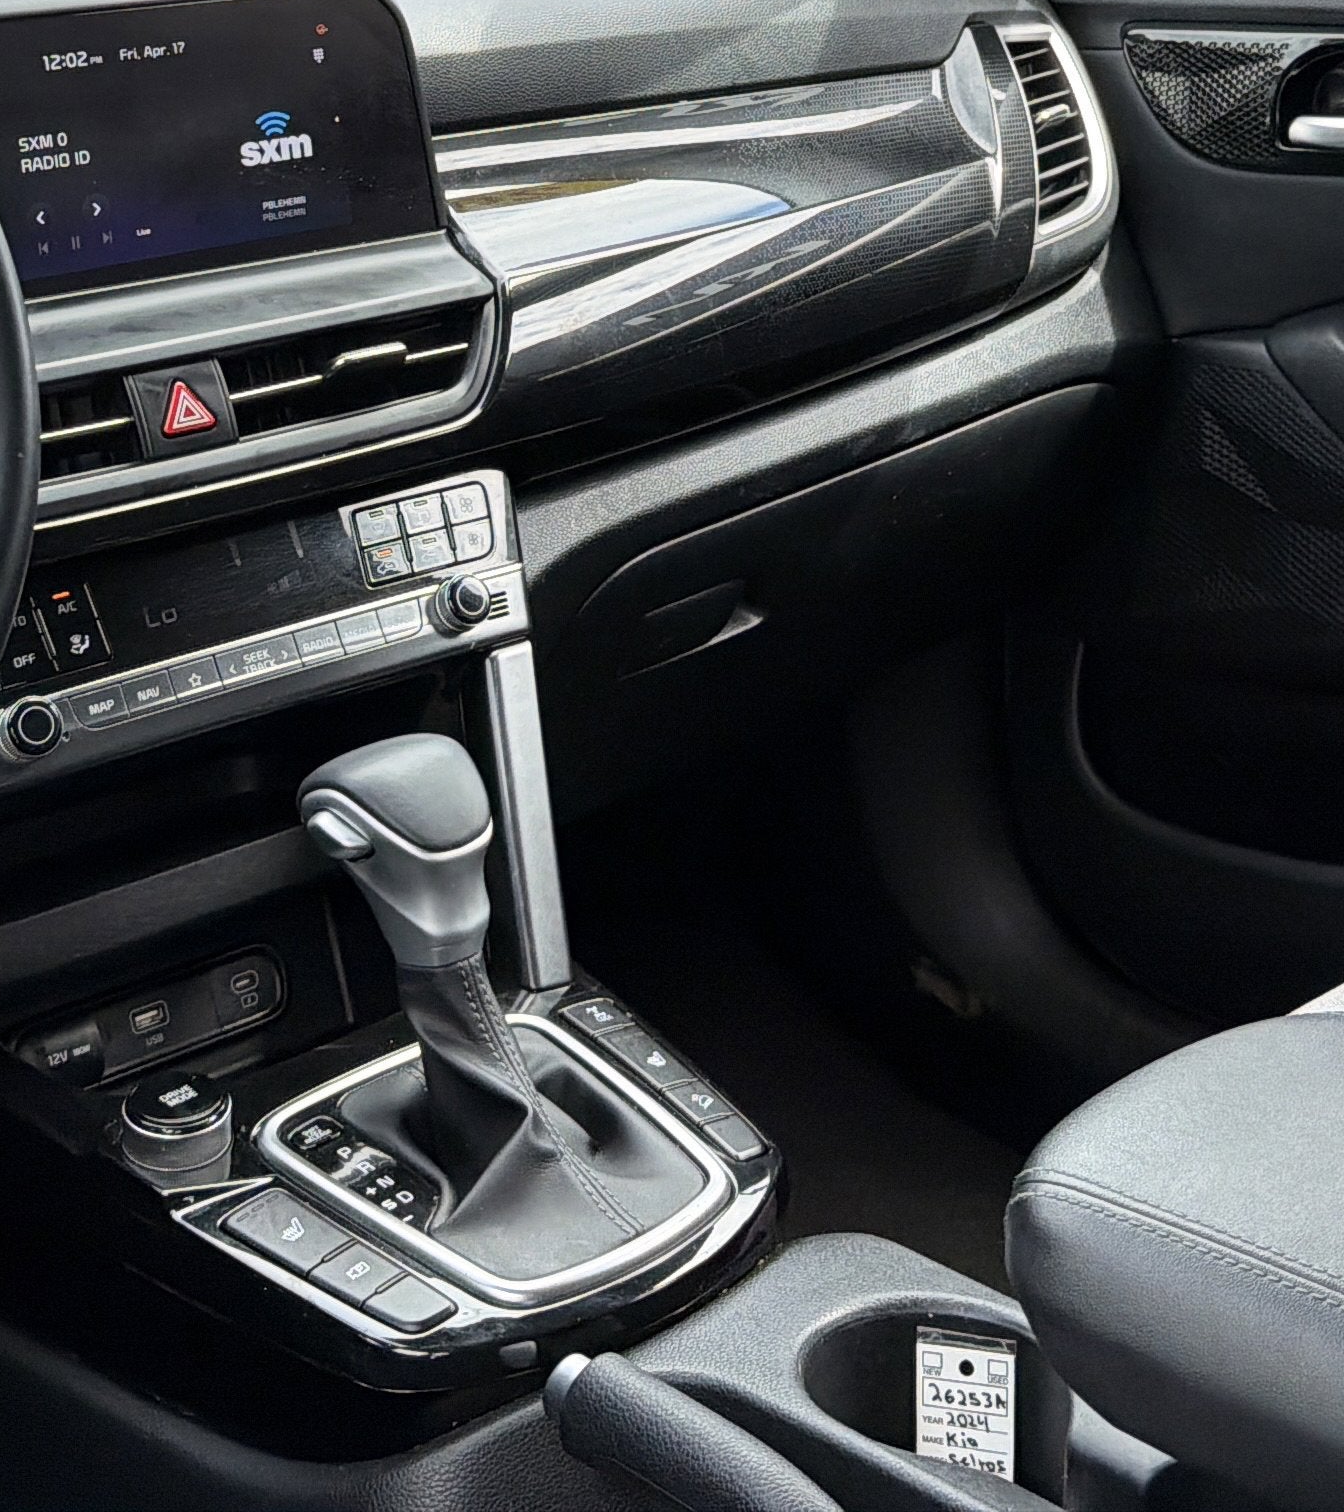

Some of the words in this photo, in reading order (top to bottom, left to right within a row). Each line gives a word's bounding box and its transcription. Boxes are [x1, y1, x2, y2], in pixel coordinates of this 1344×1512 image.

[42, 51, 89, 72] 12:02
[89, 54, 104, 65] PM
[143, 45, 171, 59] Apr.
[172, 41, 186, 55] 17
[18, 133, 54, 153] SXM
[240, 133, 313, 167] sxm
[20, 152, 71, 174] RADIO
[74, 150, 92, 166] ID
[57, 600, 79, 615] A/C
[303, 637, 334, 652] RADIO
[12, 652, 37, 669] OFF
[243, 648, 271, 665] SEEK
[242, 659, 277, 675] TRACK
[136, 686, 161, 702] NAV
[88, 698, 115, 716] MAP
[146, 1033, 164, 1045] USB
[47, 1050, 68, 1067] 12V
[158, 1084, 193, 1103] DRIVE
[165, 1089, 199, 1108] MODE
[337, 1146, 352, 1159] P
[356, 1160, 376, 1175] R
[376, 1175, 395, 1188] N
[396, 1191, 414, 1203] D
[923, 1368, 942, 1376] NEW
[987, 1375, 1008, 1386] USED
[928, 1383, 1006, 1409] 26253A
[922, 1415, 944, 1426] YEAR
[946, 1413, 990, 1432] 2024
[922, 1435, 944, 1446] MAKE
[946, 1432, 978, 1448] Kia
